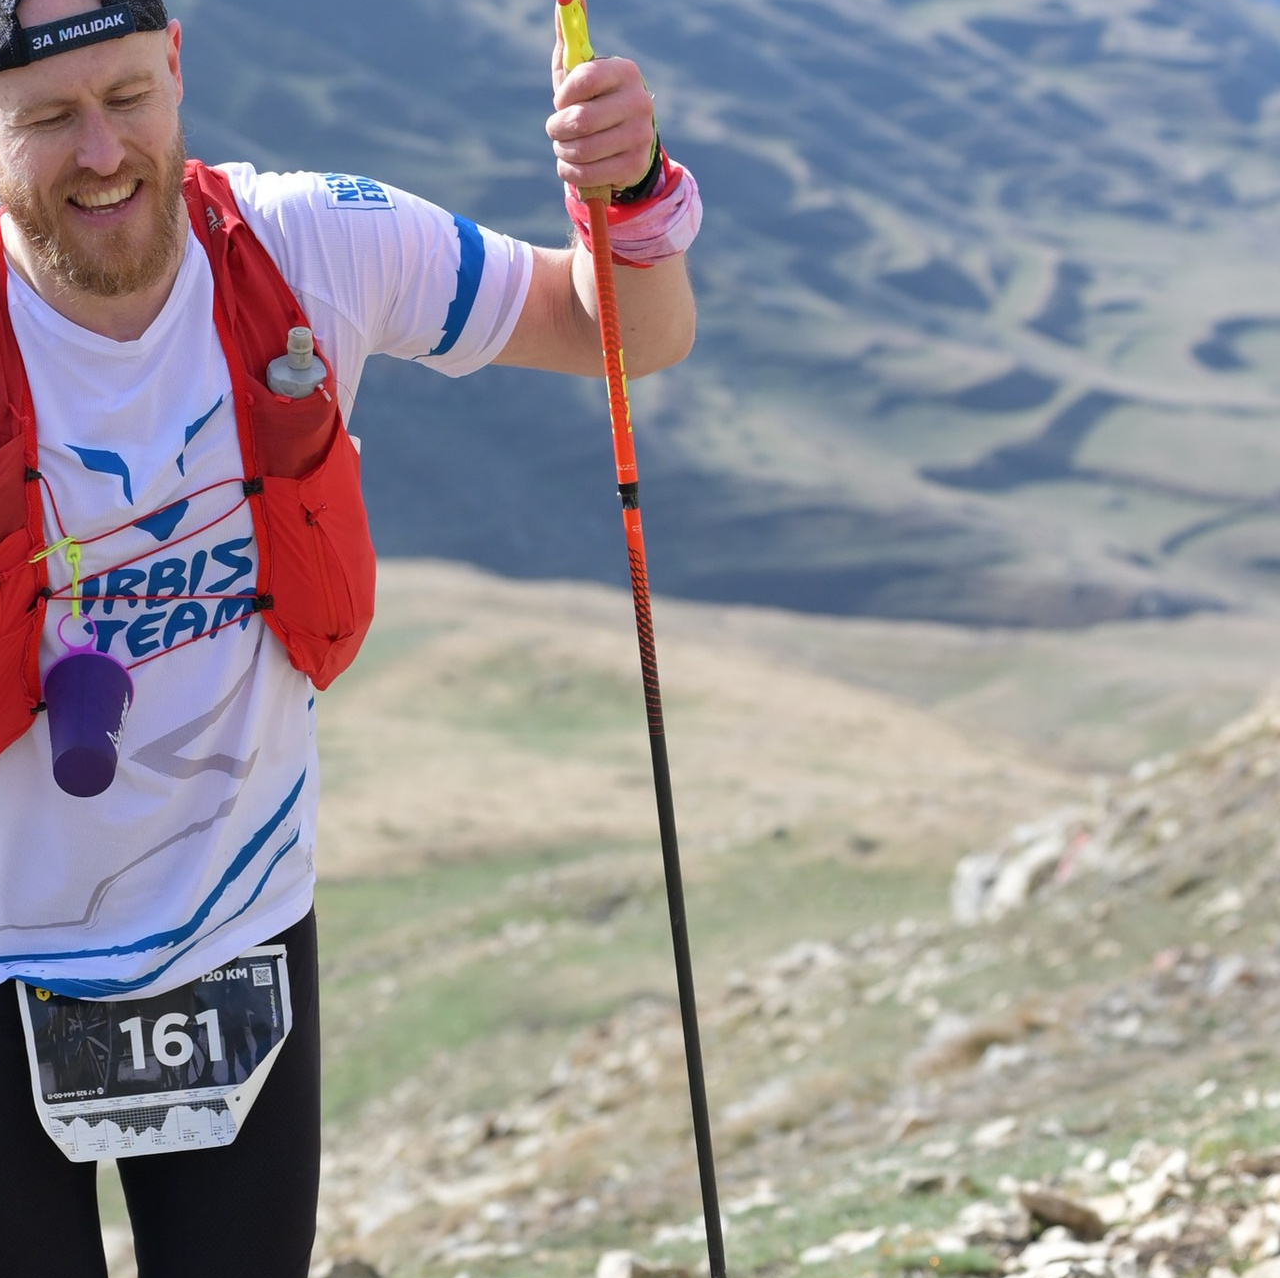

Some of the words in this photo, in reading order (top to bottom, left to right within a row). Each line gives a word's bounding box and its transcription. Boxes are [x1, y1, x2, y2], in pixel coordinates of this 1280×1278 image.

[32, 34, 53, 50] 3A
[58, 13, 125, 42] MALIDAK
[82, 537, 253, 615] IRBIS
[83, 587, 256, 657] TEAM
[201, 970, 224, 982] 120
[226, 968, 248, 980] KM
[119, 1009, 223, 1070] 161
